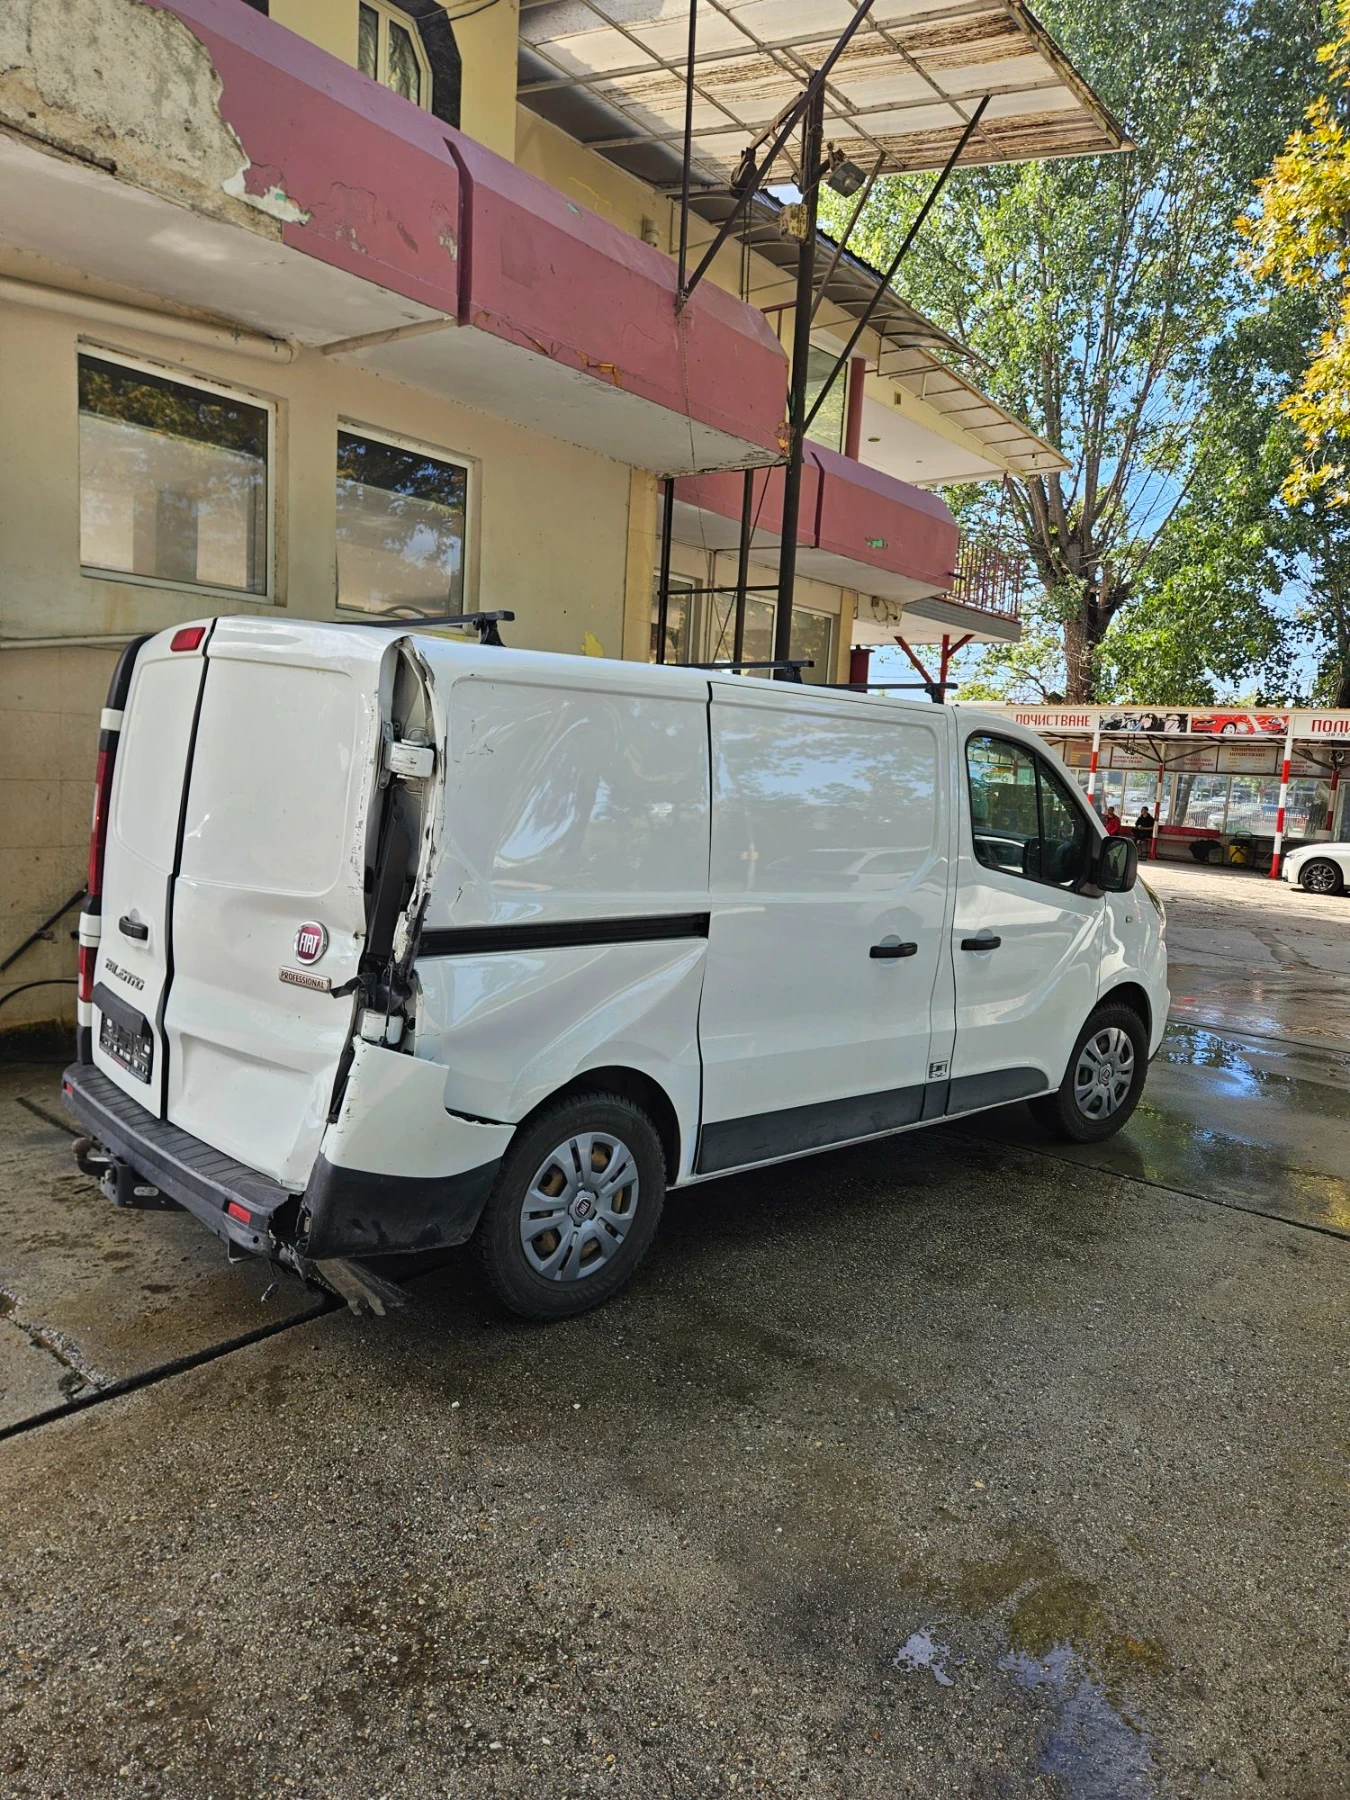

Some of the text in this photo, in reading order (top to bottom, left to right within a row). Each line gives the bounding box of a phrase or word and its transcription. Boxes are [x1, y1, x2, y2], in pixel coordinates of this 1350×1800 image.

[1015, 714, 1091, 727] ПОЧИСТВАНЕ
[299, 932, 319, 954] FIAT
[281, 971, 324, 988] PROFESSIONAL
